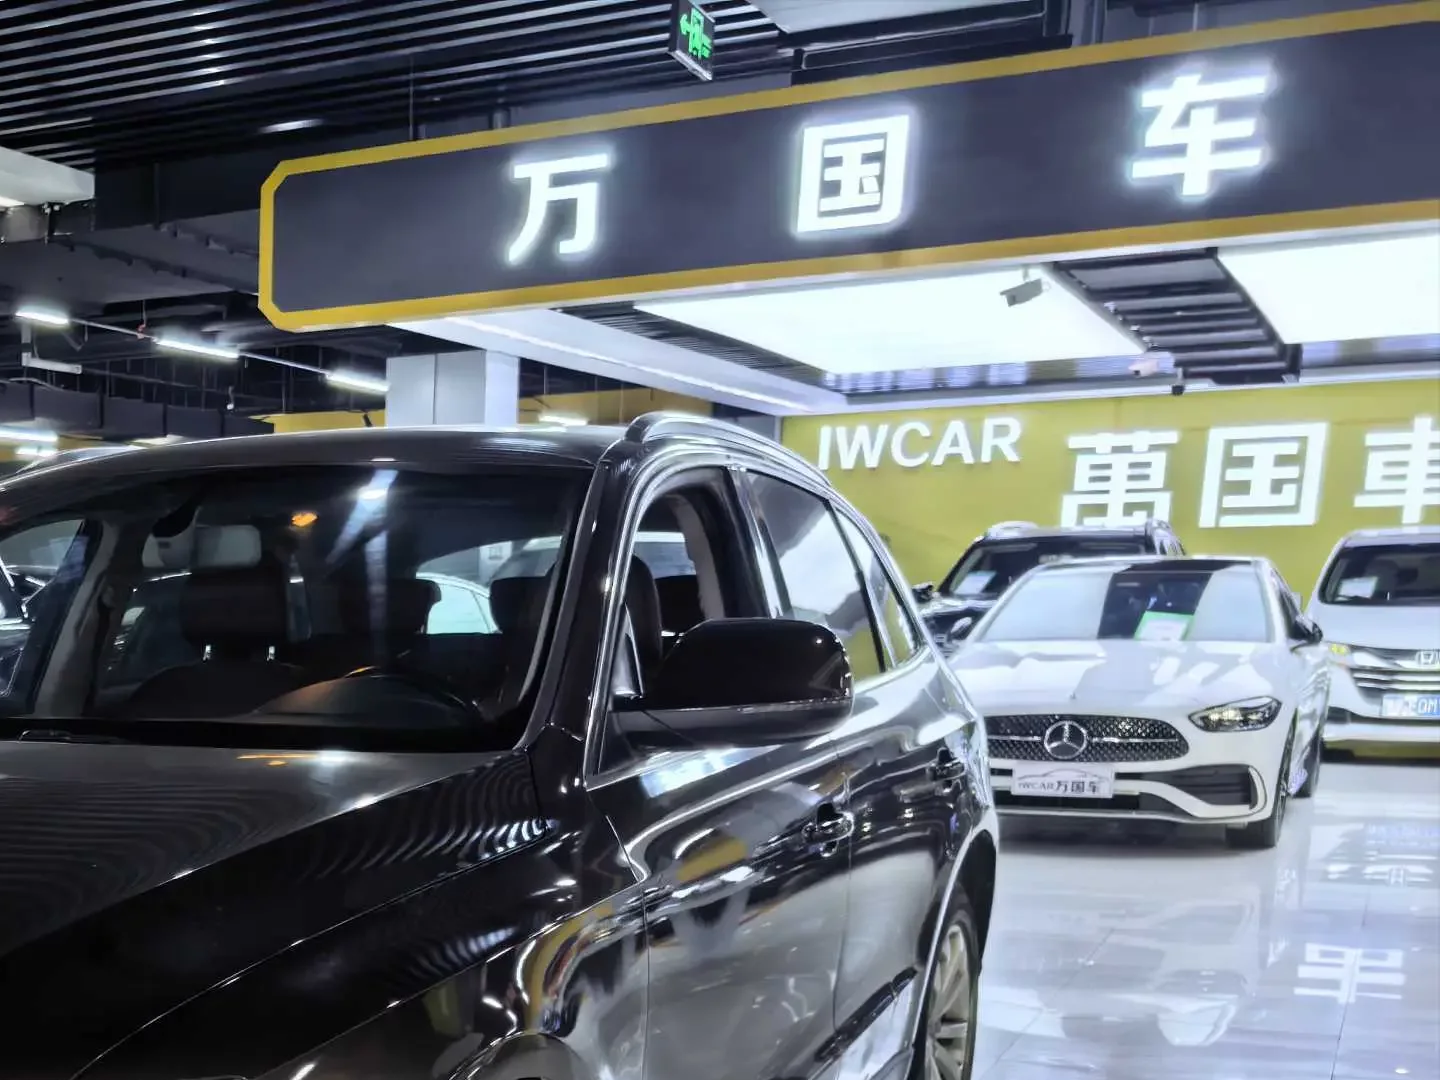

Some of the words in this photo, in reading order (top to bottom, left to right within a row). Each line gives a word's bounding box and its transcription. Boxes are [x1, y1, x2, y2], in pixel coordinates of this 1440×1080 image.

[508, 73, 1267, 263] 万国车
[817, 416, 1023, 471] IWCAR
